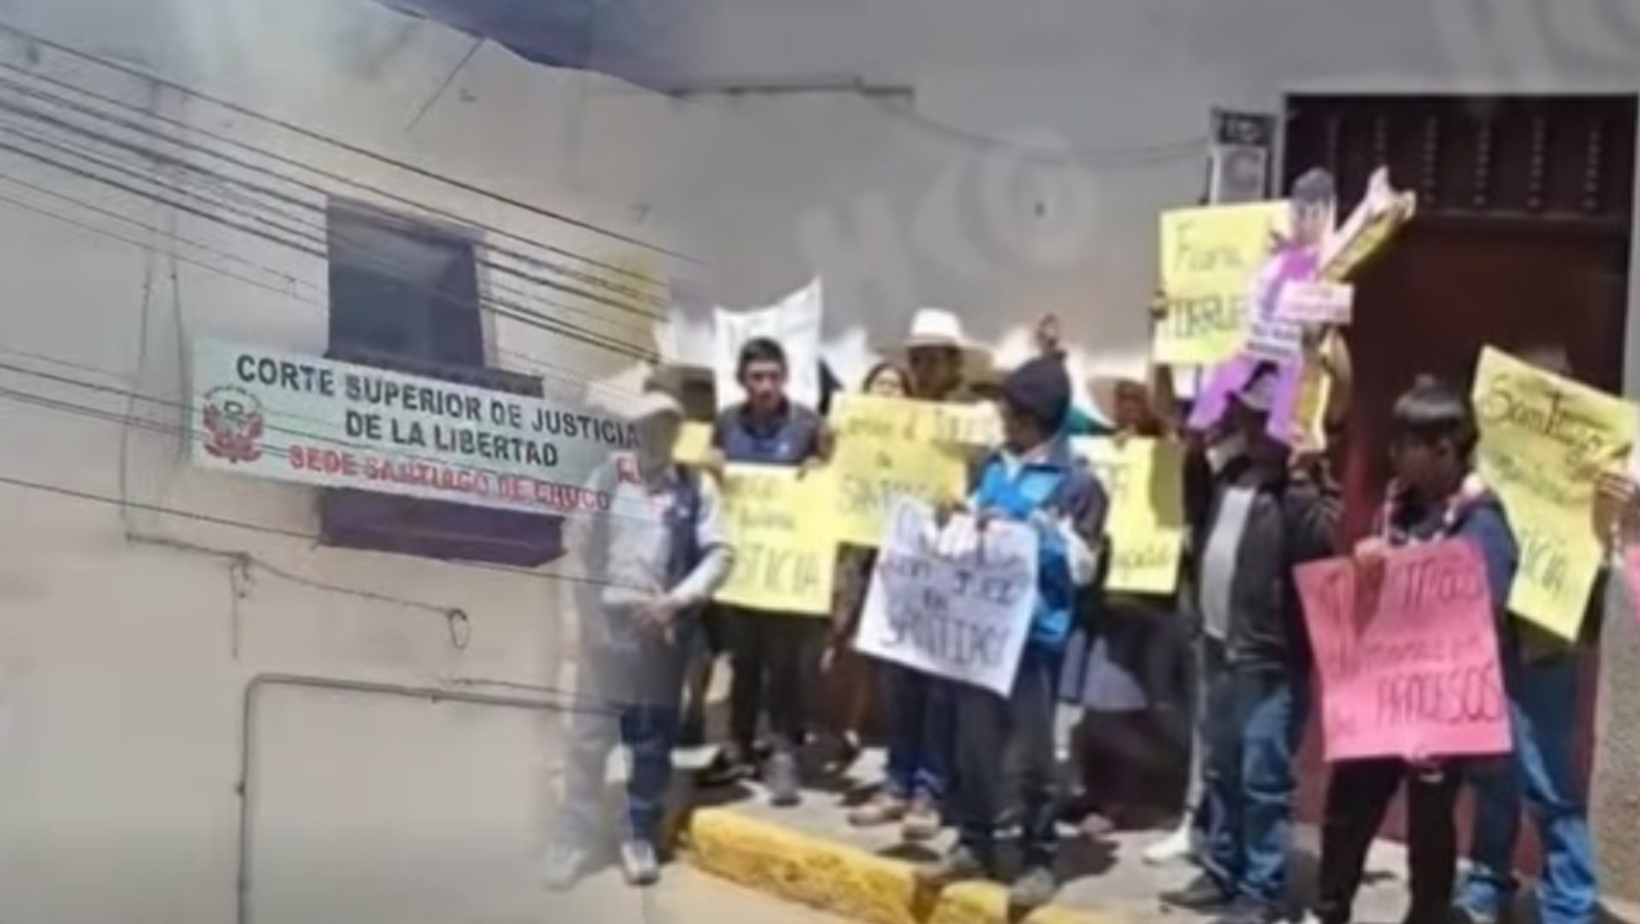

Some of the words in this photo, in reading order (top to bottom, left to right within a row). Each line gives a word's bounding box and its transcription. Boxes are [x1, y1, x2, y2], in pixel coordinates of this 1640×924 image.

[236, 354, 335, 397] CORTE
[345, 373, 481, 421] SUPERIOR
[491, 400, 521, 430] DE
[532, 408, 641, 449] JUSTICIA
[345, 409, 382, 439] DE
[391, 418, 426, 447] LA
[433, 424, 558, 467] LIBERTAD
[290, 444, 355, 476] SEDE
[364, 456, 489, 497] SANTIAGO
[498, 475, 529, 501] DE
[533, 480, 610, 511] CHUCO
